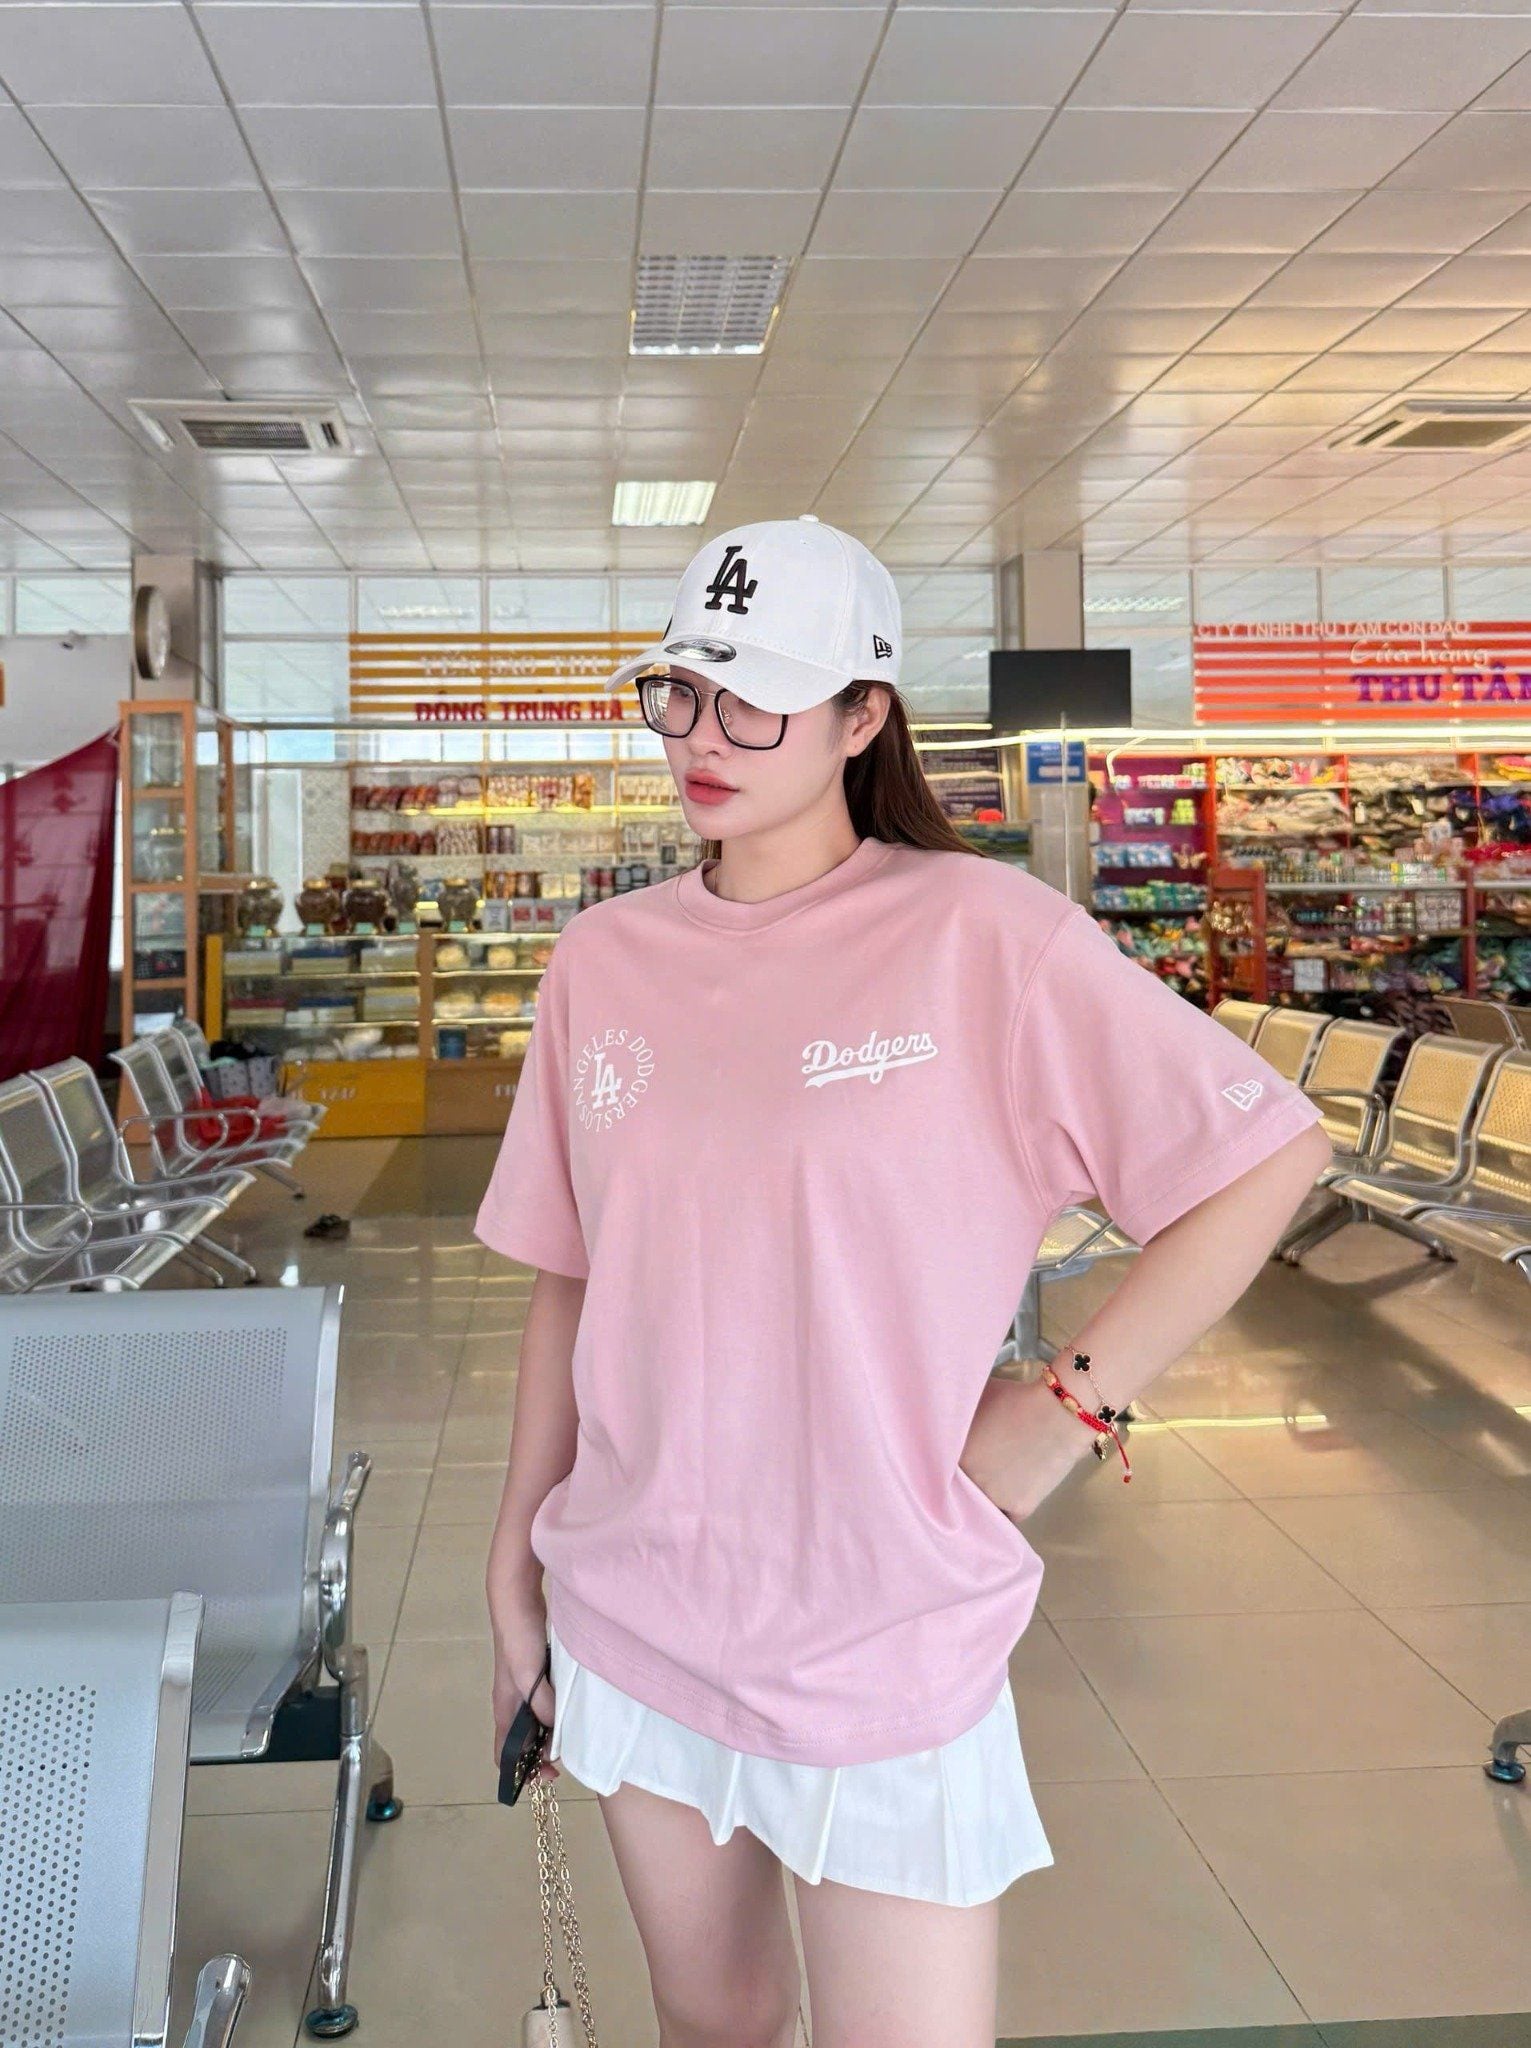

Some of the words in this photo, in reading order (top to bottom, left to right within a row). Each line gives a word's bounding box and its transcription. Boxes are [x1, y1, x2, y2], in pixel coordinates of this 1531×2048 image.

[705, 545, 758, 615] LA
[1246, 622, 1296, 638] TNHH
[1352, 673, 1443, 702] THU
[591, 1052, 622, 1109] LA
[801, 1030, 938, 1087] Dodgers
